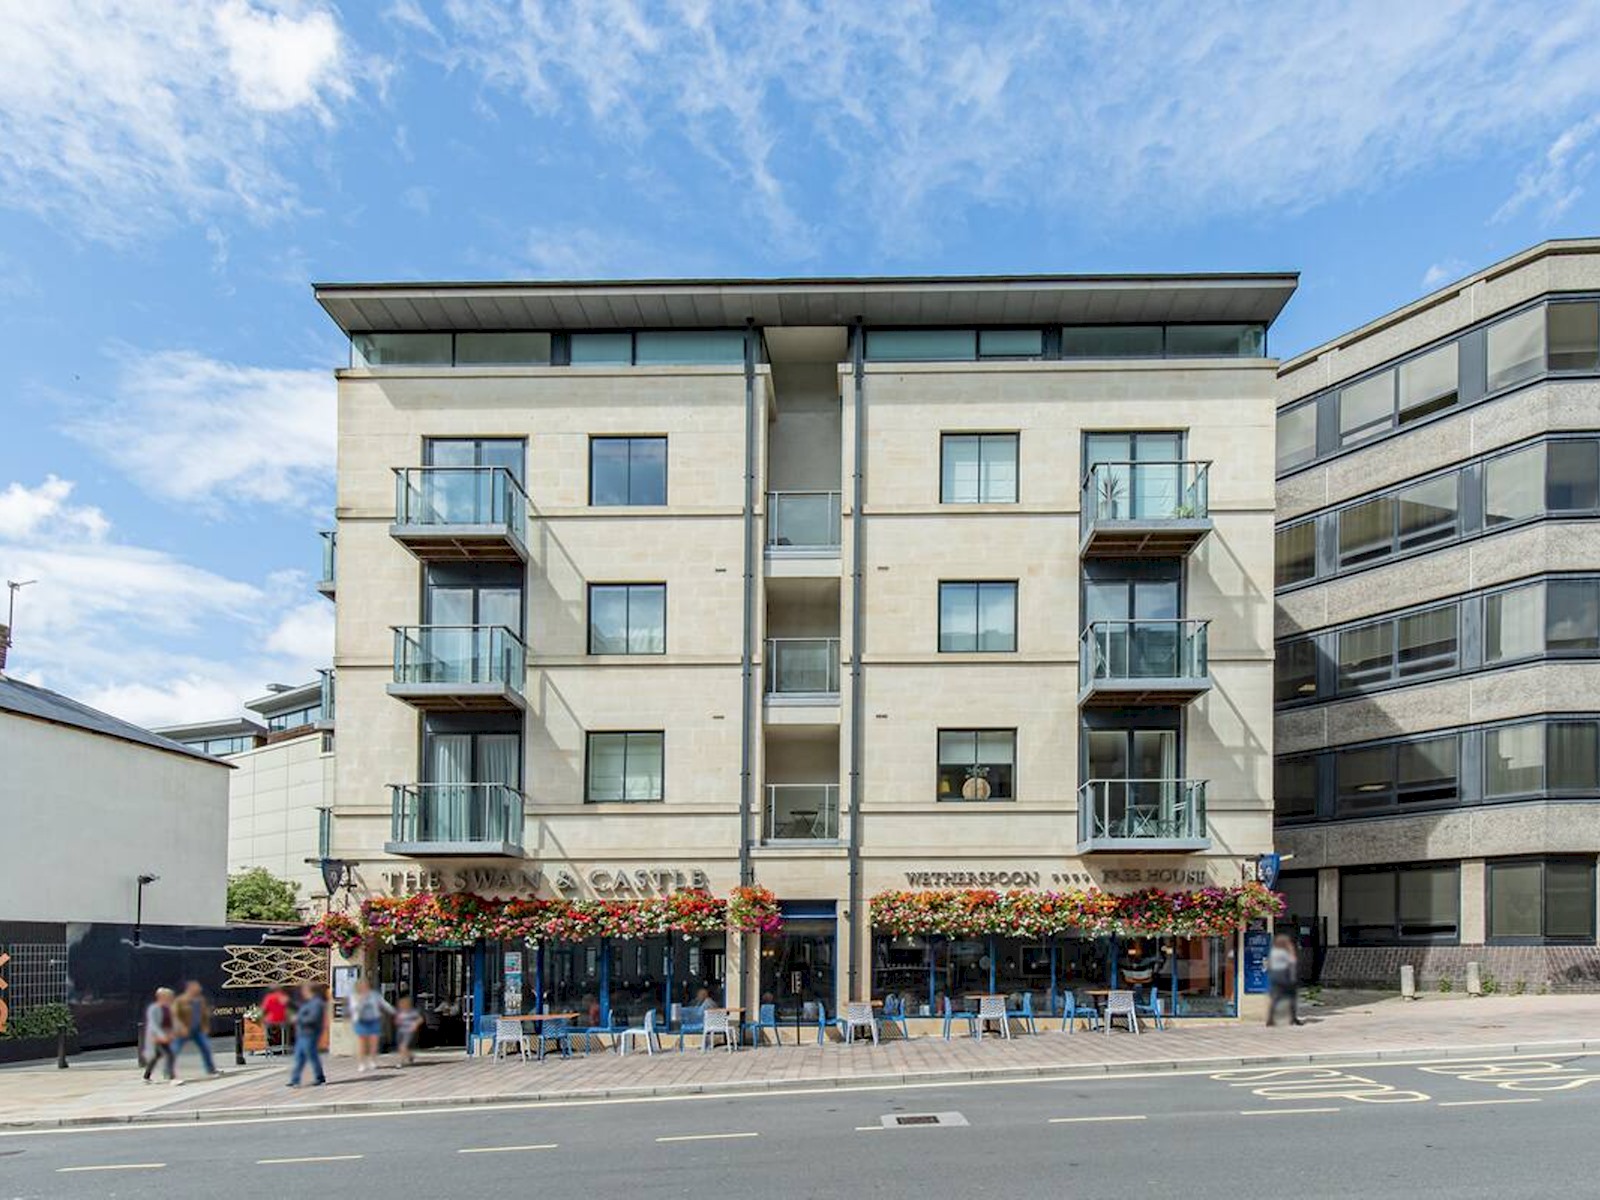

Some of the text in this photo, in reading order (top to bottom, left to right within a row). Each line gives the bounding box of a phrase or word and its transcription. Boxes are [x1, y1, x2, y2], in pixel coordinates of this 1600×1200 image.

[382, 869, 708, 892] THE SWAN & CASTLE
[904, 868, 1206, 887] WETHERSPOON FREE HOUSE
[1209, 1068, 1431, 1103] STOP
